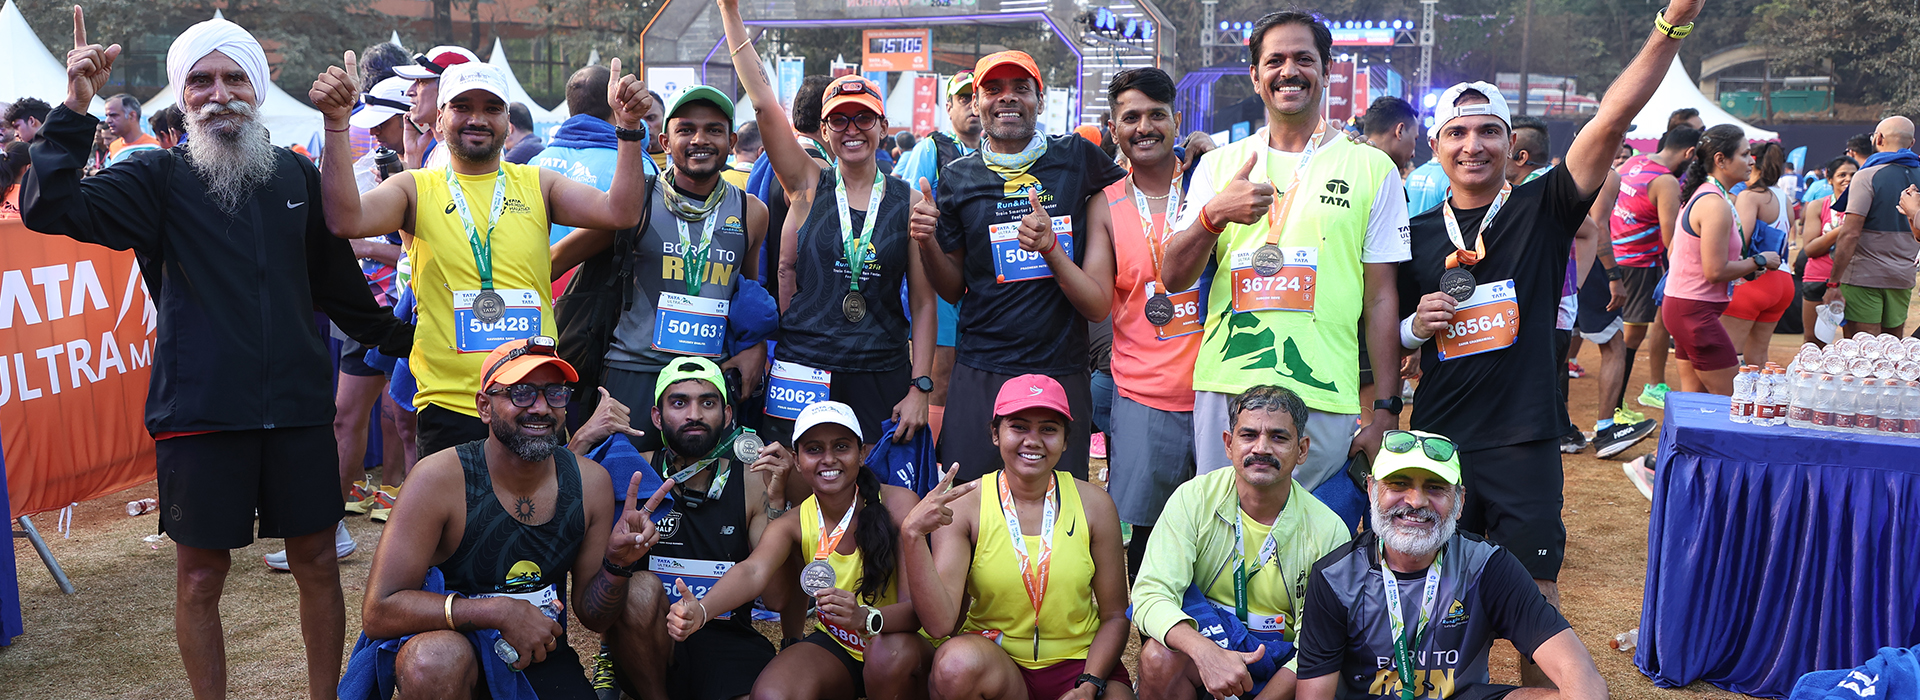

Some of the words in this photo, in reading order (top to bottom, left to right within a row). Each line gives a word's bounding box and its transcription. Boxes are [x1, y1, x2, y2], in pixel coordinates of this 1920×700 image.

[540, 158, 567, 169] TATA
[996, 195, 1054, 209] Run&Ri2Fit
[1320, 195, 1350, 208] TATA
[716, 249, 735, 262] TO
[1006, 248, 1045, 263] 509
[1241, 276, 1301, 293] 36724
[470, 317, 529, 332] 50428
[668, 320, 717, 338] 50163
[1446, 312, 1506, 339] 36564
[770, 385, 816, 404] 52062
[1614, 426, 1634, 439] HOKA
[1433, 650, 1459, 665] TO
